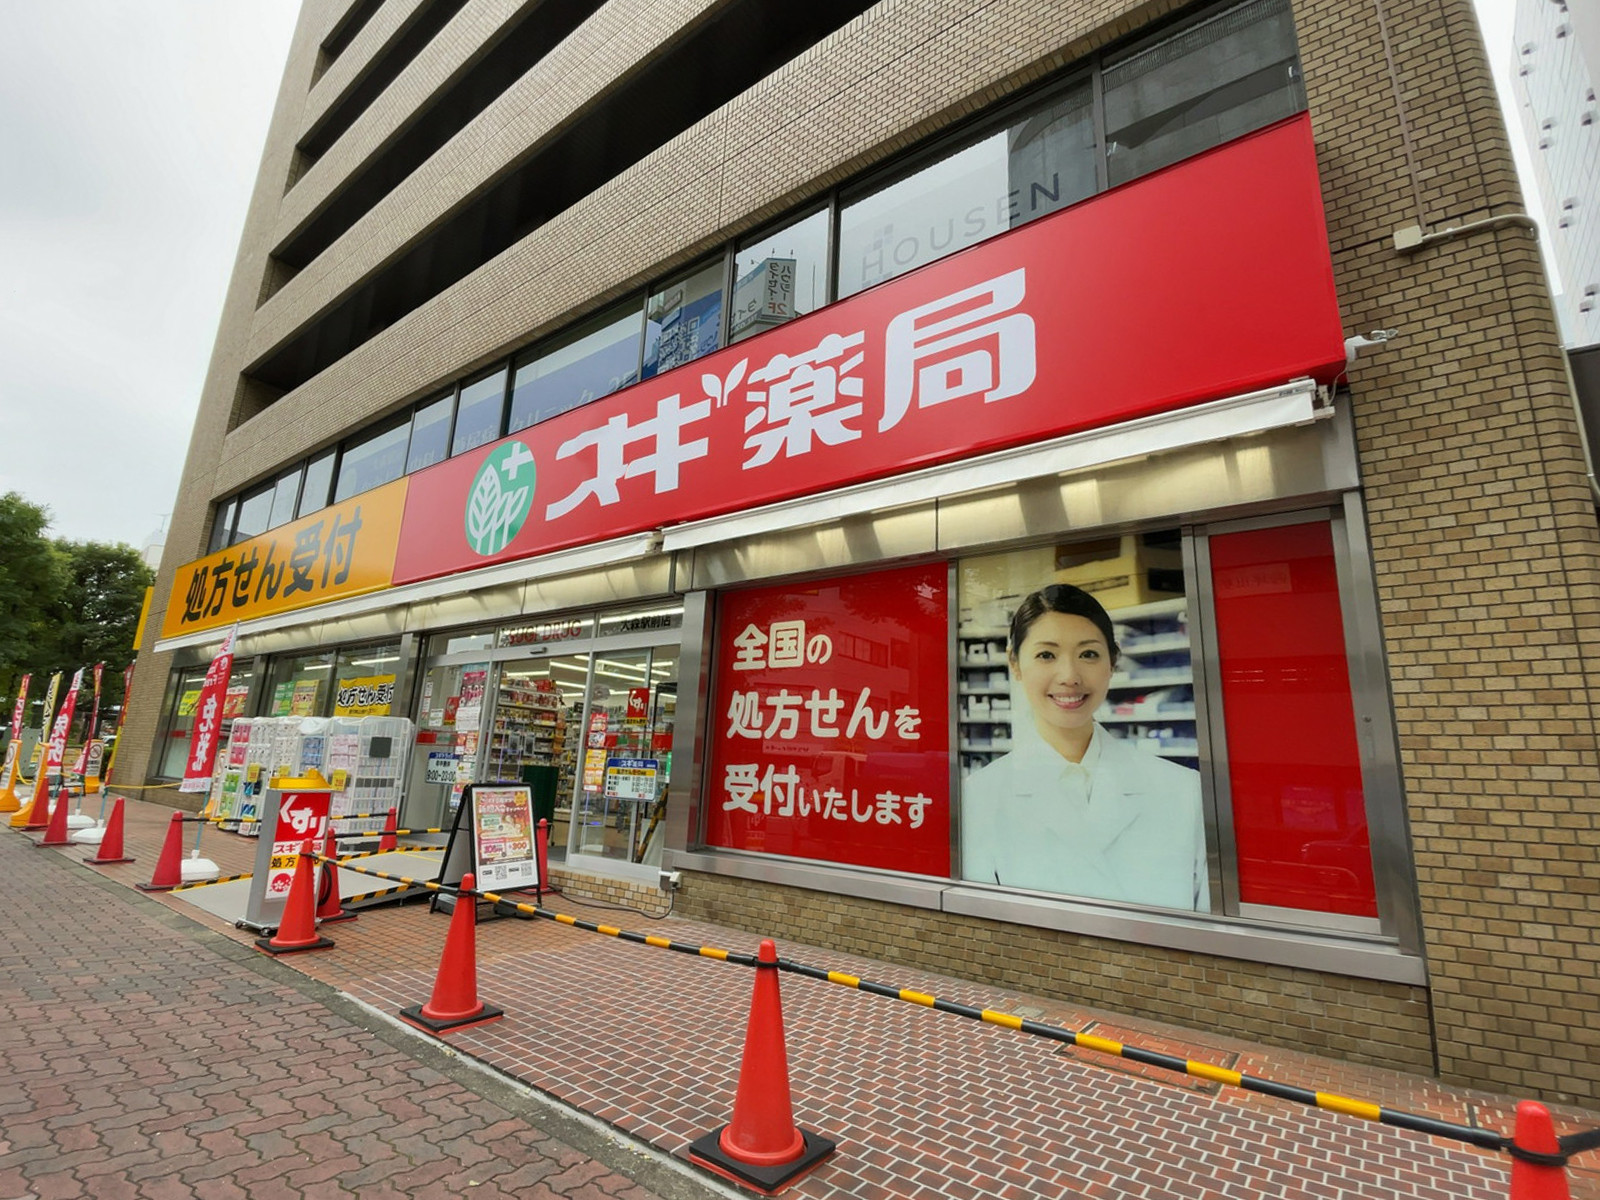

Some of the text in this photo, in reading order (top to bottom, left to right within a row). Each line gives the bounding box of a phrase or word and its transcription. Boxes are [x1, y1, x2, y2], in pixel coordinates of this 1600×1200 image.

[862, 173, 1060, 282] HOUSEN
[545, 268, 1037, 521] スギ薬局
[181, 505, 362, 624] 処方せん受付
[733, 620, 832, 670] 全国の
[727, 687, 921, 739] 処方せんを
[280, 794, 326, 838] くすり
[722, 763, 932, 829] 受付いたします
[273, 842, 322, 853] スギ局
